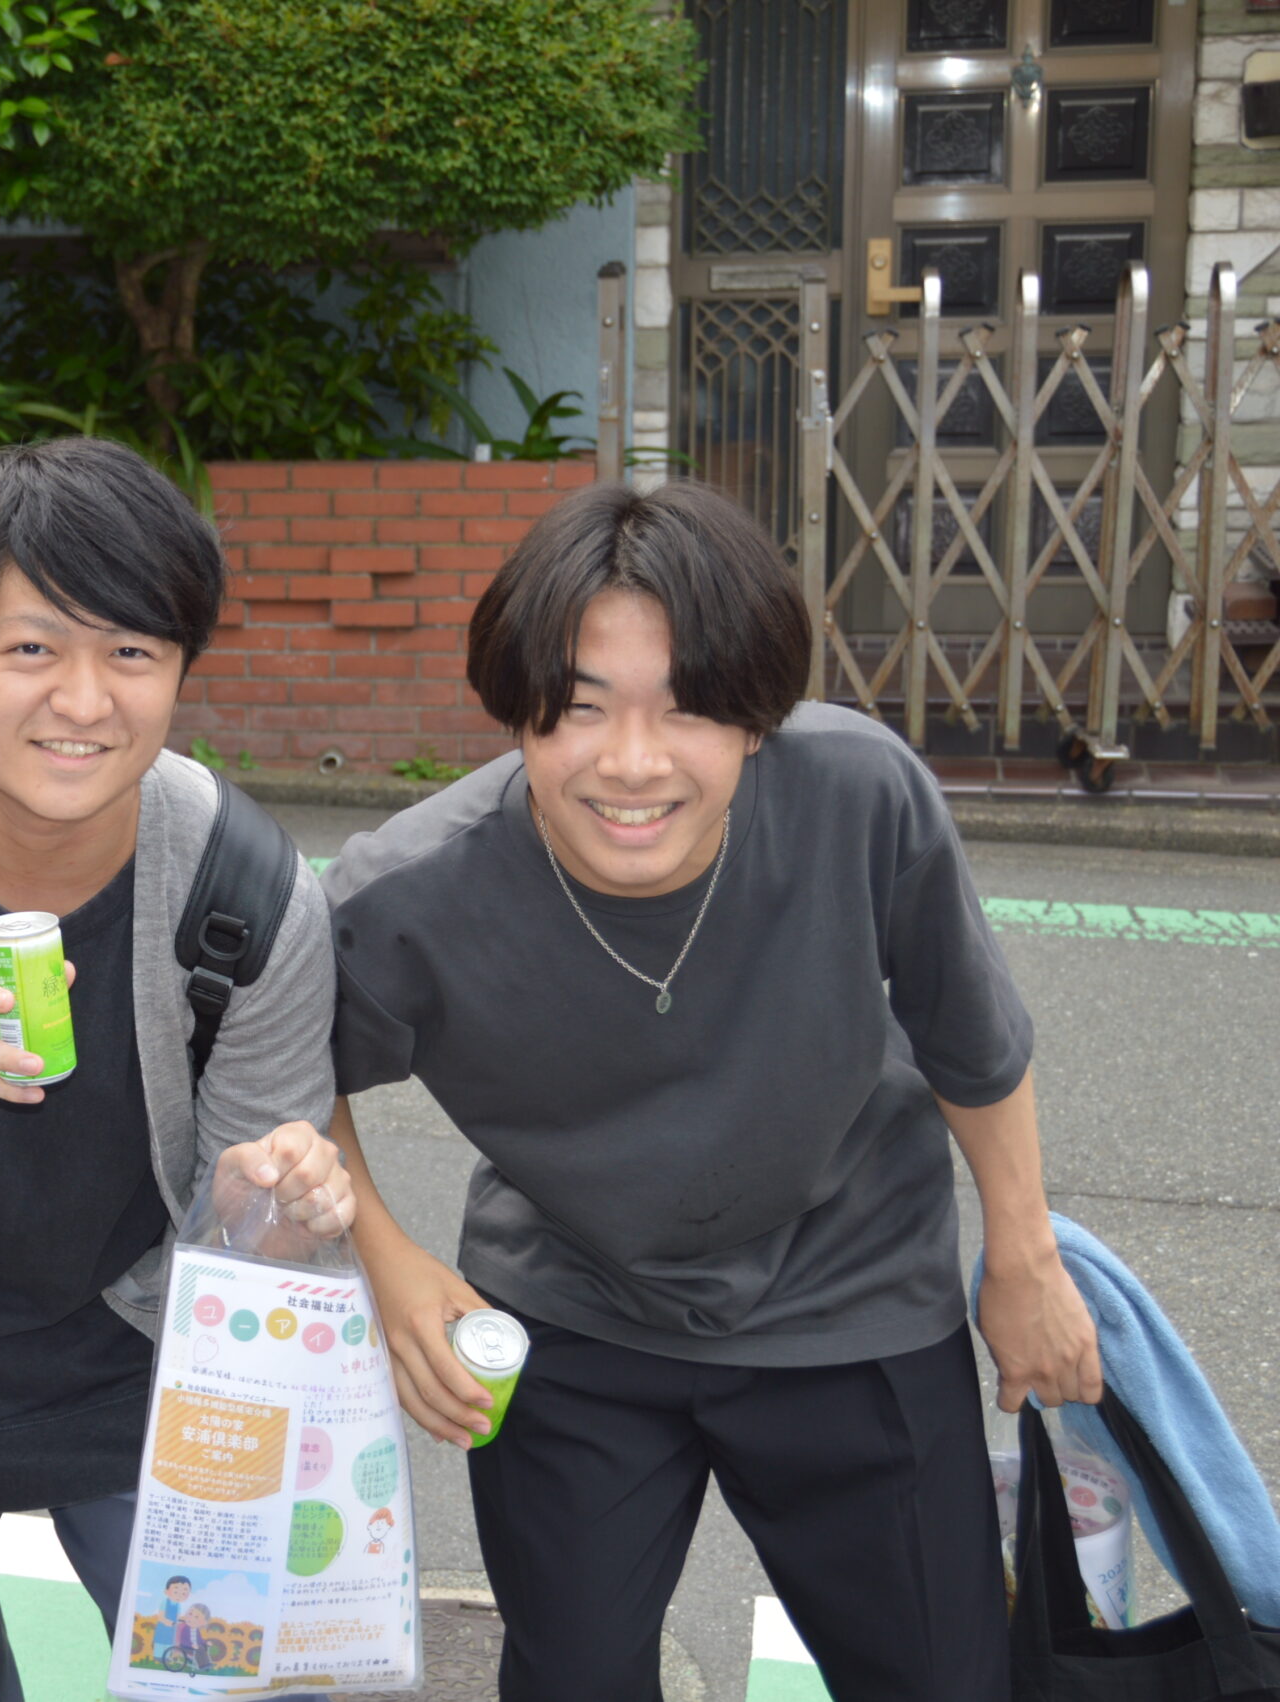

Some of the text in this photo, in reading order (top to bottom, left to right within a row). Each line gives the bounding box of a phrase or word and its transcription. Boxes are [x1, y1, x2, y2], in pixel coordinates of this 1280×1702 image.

[287, 1295, 357, 1313] 社会福祉法人
